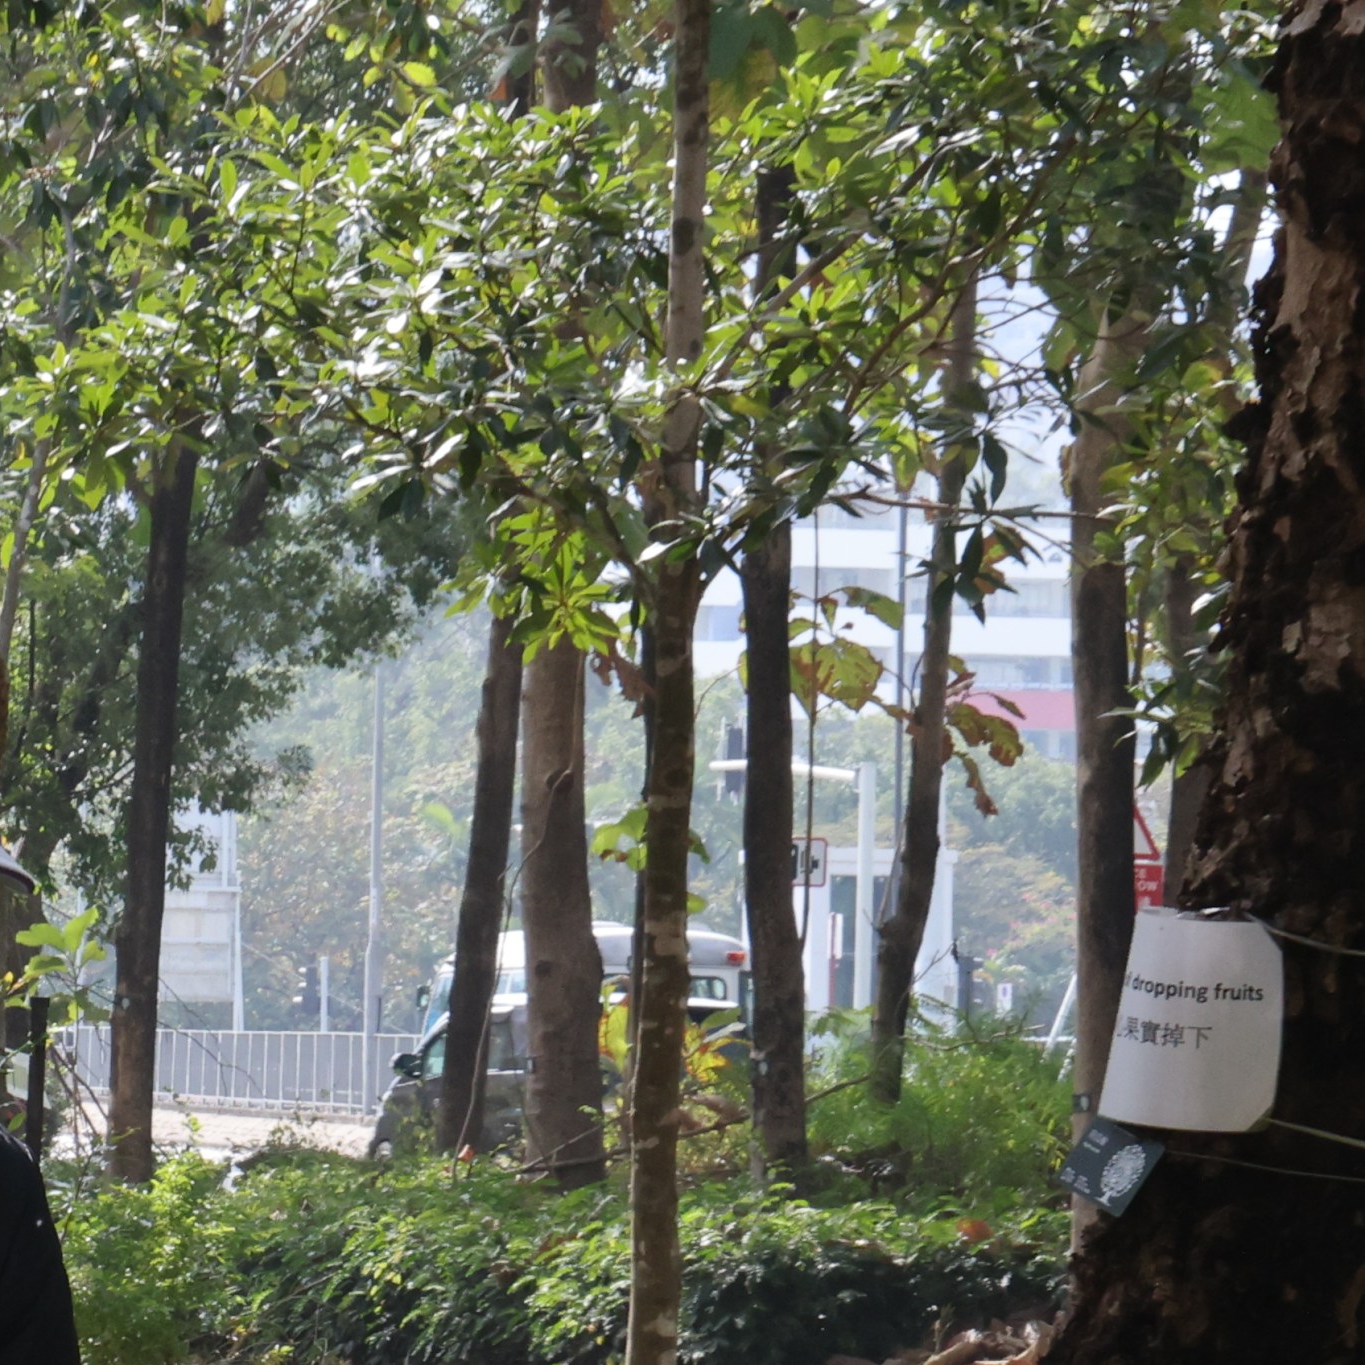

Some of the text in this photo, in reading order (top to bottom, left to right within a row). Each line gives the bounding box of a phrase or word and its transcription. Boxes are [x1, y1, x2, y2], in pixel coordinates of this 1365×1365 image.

[1132, 974, 1208, 1003] dropping
[1214, 982, 1264, 1001] fruits
[1117, 1016, 1213, 1049] 果實掉下
